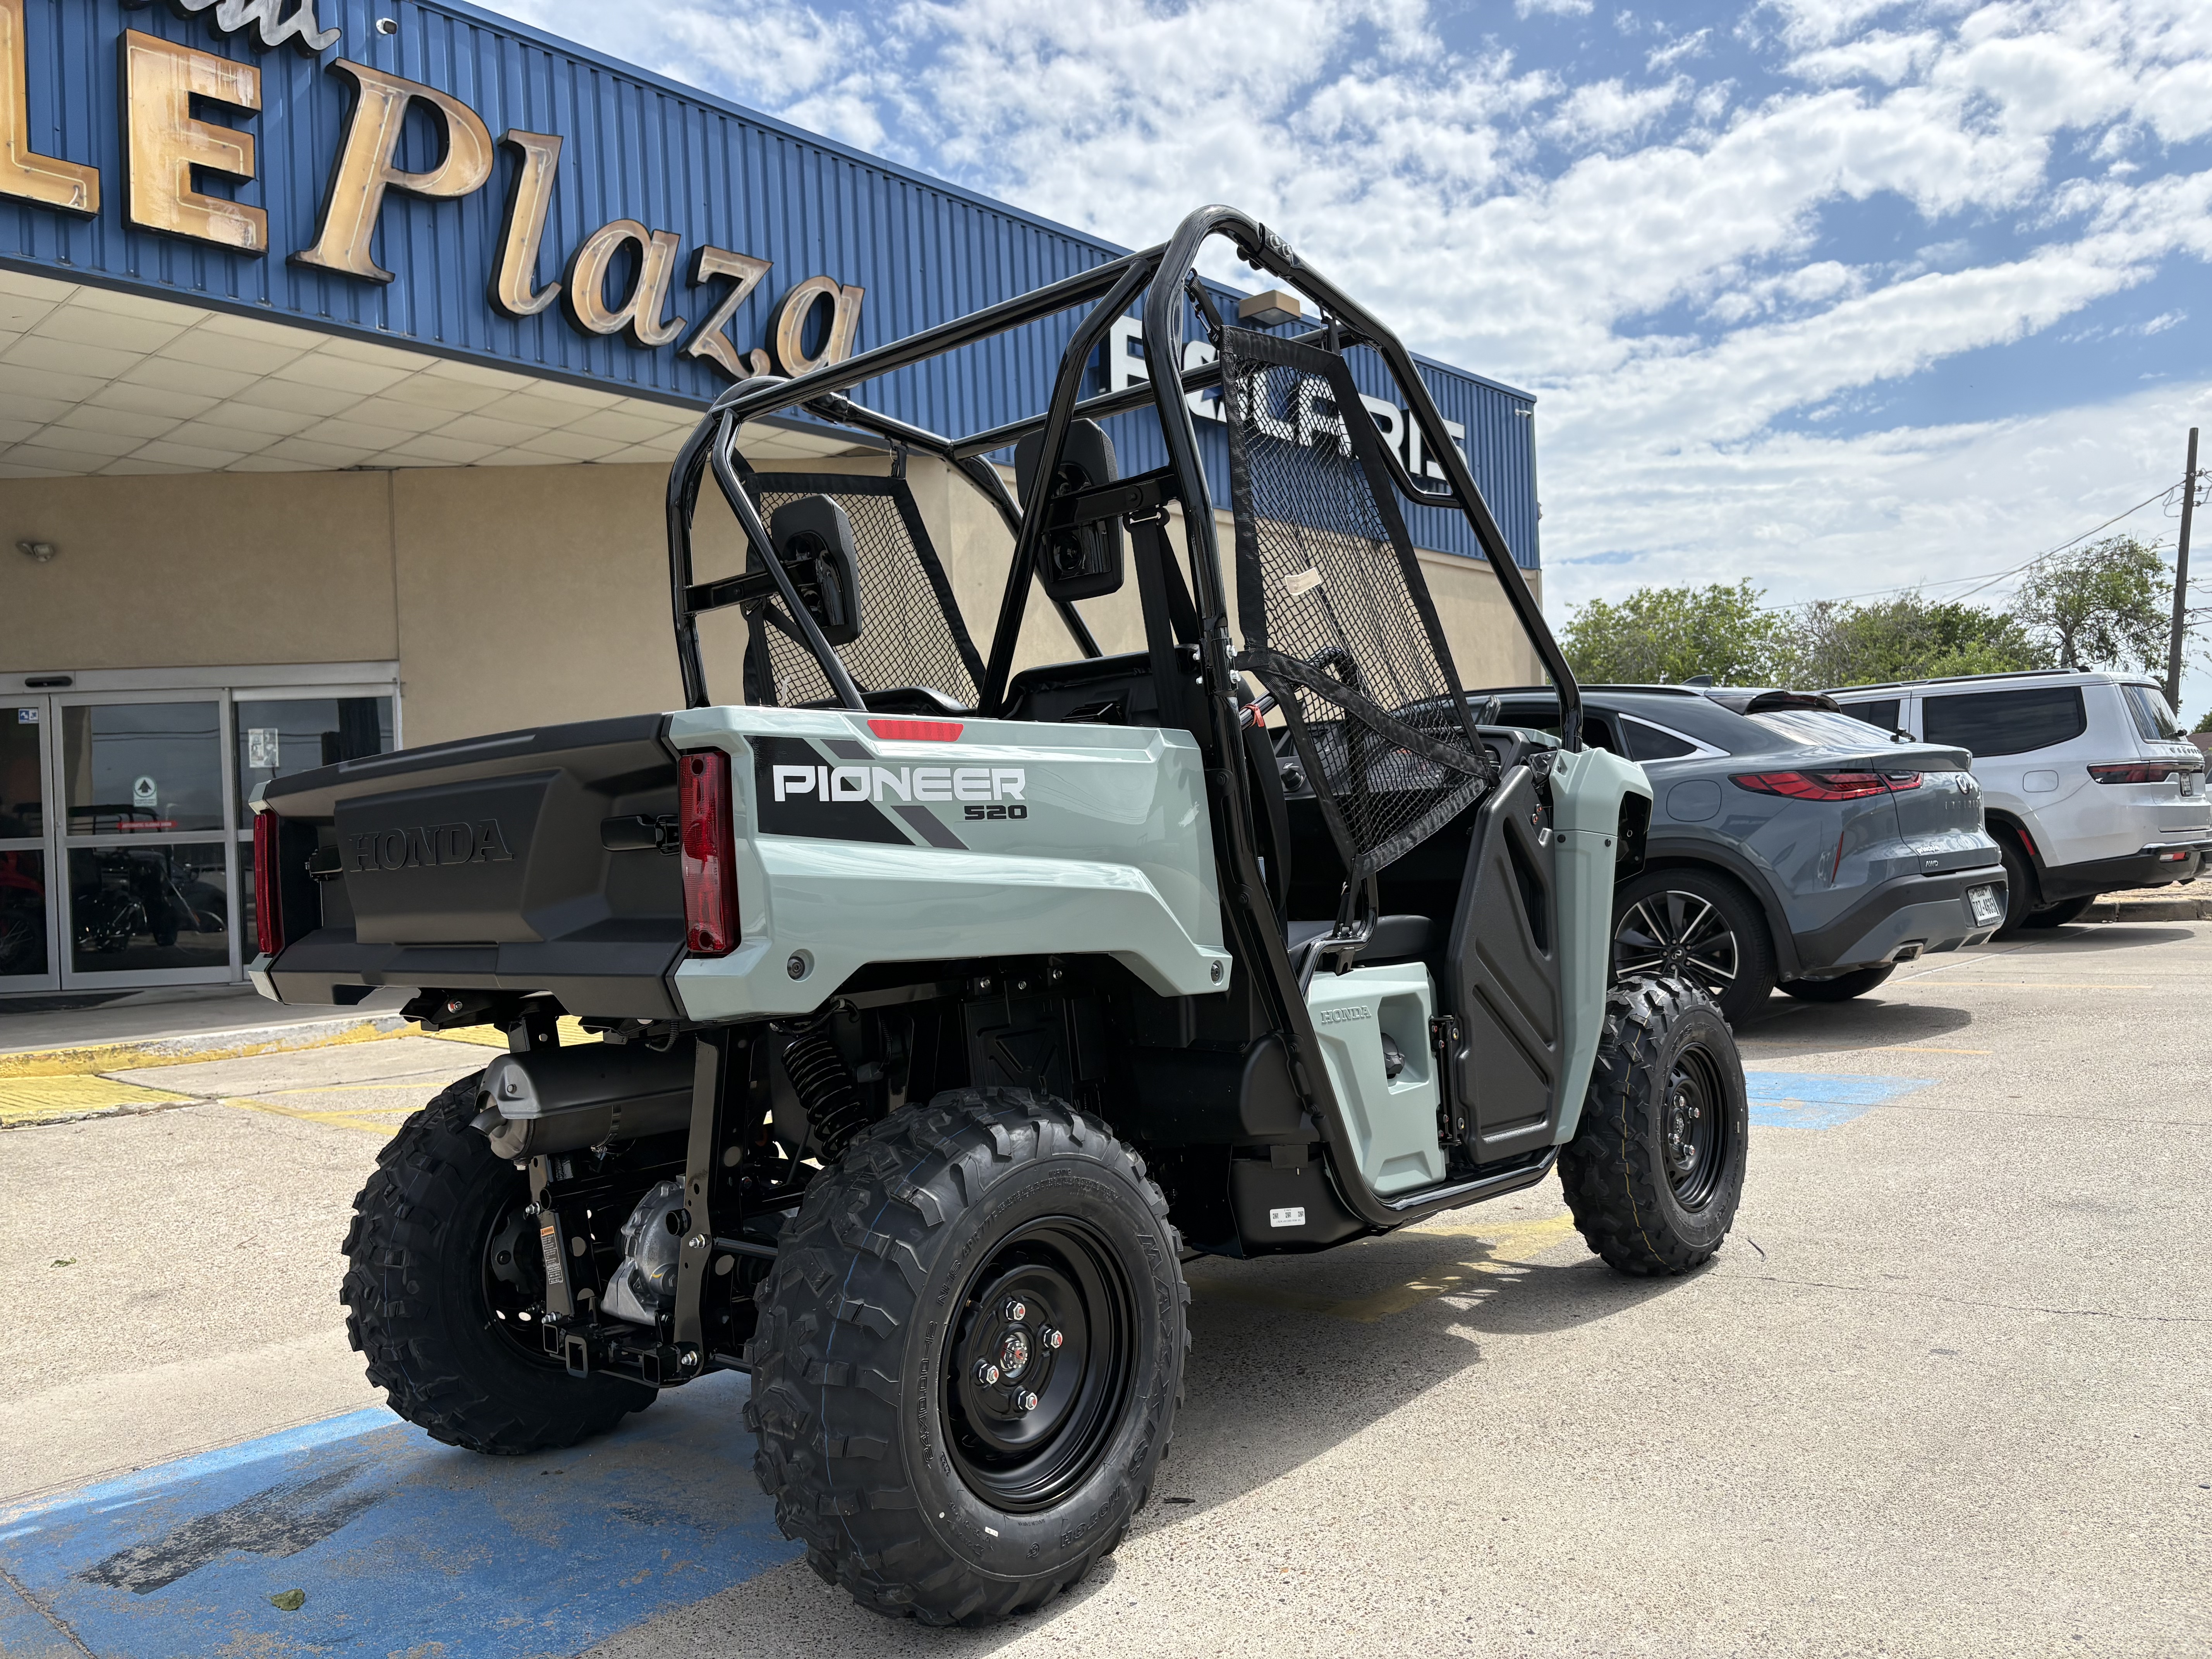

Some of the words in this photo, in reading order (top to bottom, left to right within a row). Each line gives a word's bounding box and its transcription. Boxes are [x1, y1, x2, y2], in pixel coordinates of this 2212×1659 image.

[286, 57, 864, 383] Plaza
[773, 765, 1025, 802] PIONEER
[964, 805, 1027, 820] 520
[349, 818, 514, 872] HONDA
[1321, 1006, 1372, 1024] HONDA
[937, 1259, 962, 1305] NHS
[1128, 1235, 1172, 1479] MAXXIS
